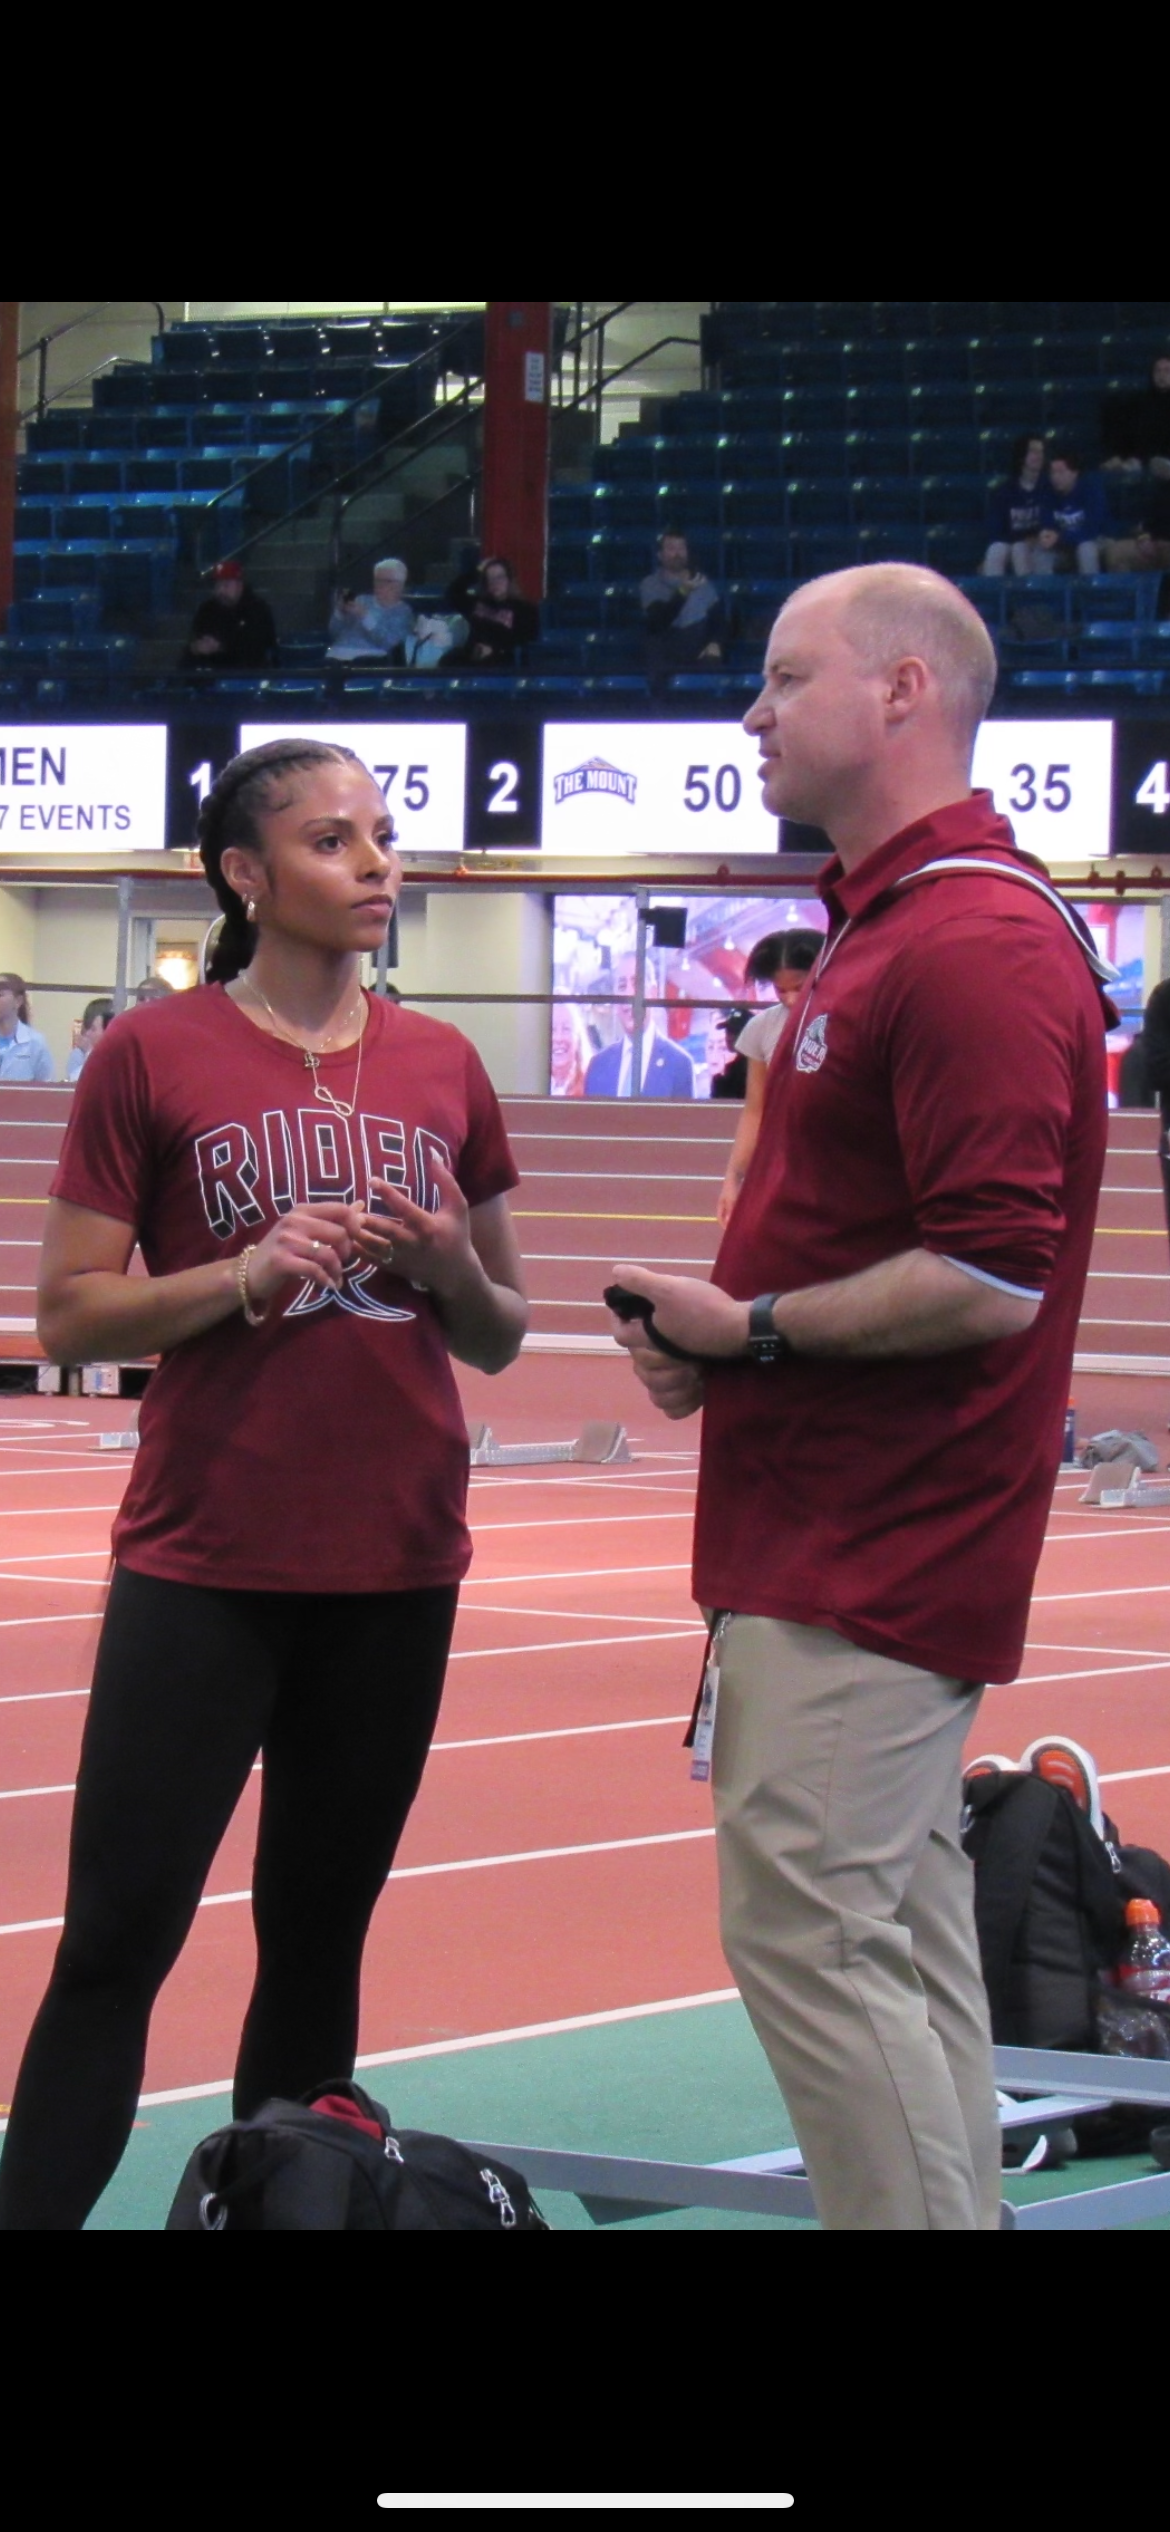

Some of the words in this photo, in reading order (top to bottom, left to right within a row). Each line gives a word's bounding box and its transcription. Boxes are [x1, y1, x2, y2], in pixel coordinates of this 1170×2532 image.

[0, 747, 66, 786] EN
[189, 761, 212, 811] 1
[373, 764, 430, 811] 75
[487, 761, 519, 813] 2
[556, 772, 584, 801] THE
[586, 770, 636, 801] MOUNT
[683, 764, 742, 813] 50
[1009, 763, 1071, 813] 35
[1135, 761, 1170, 814] 4
[20, 804, 131, 831] EVENTS
